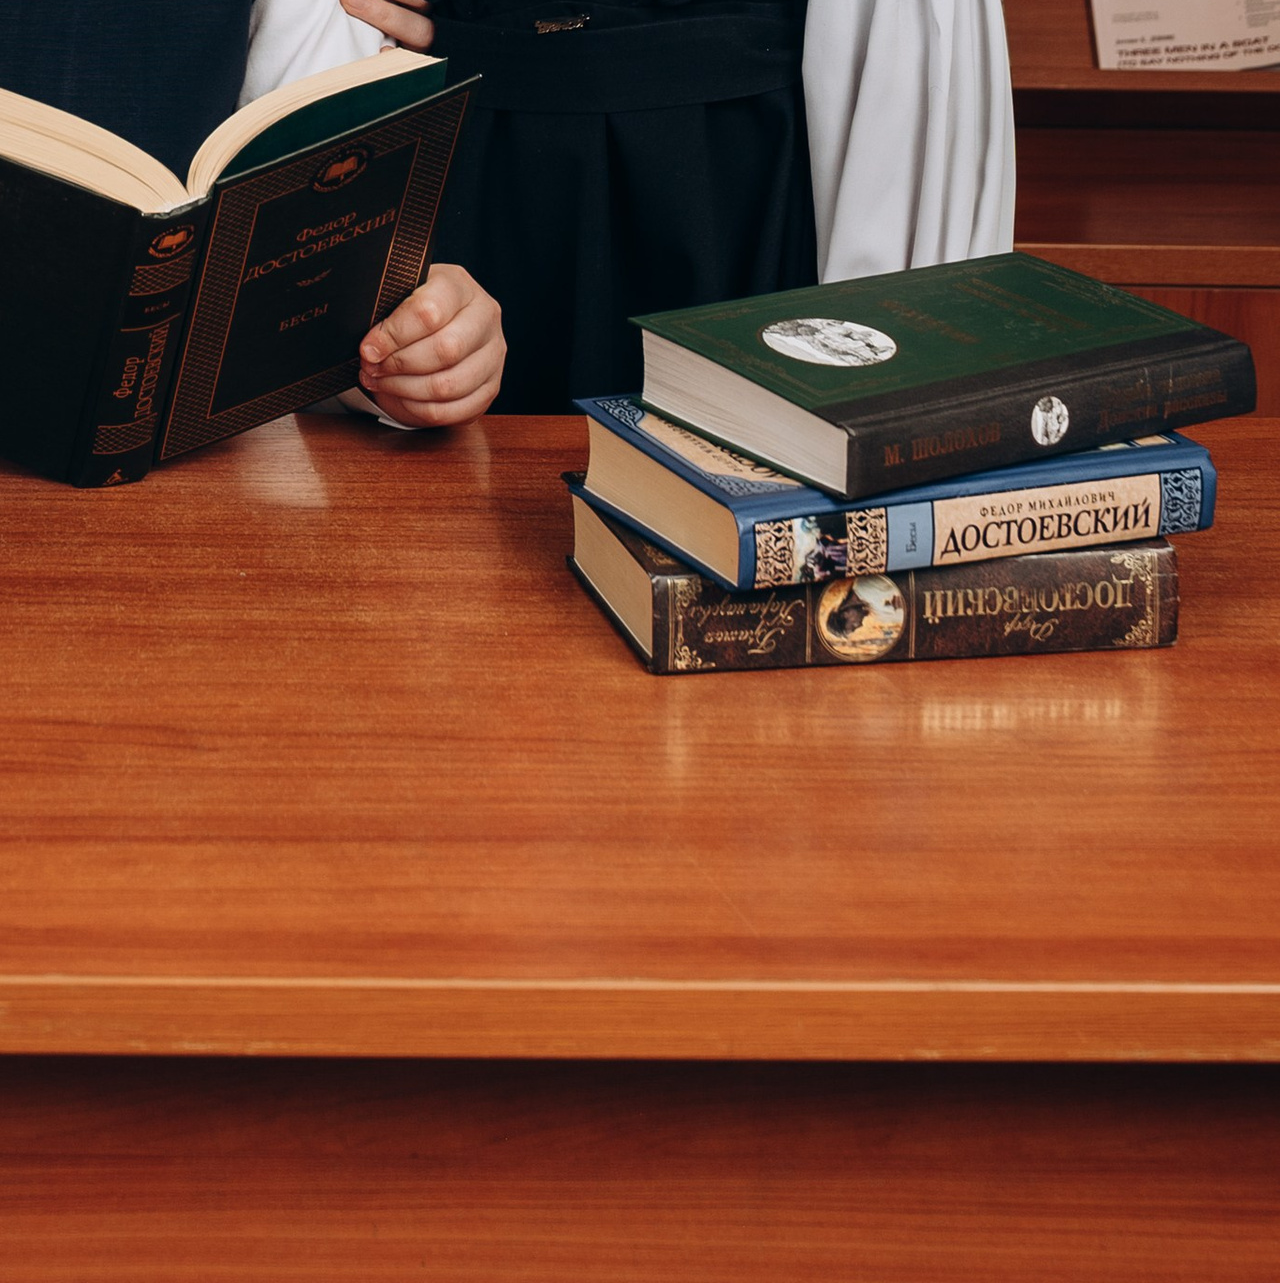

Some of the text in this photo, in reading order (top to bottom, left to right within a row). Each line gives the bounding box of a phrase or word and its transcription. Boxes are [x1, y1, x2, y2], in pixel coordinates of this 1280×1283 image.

[242, 207, 397, 284] ДОСТОЕВСКИЙ
[296, 211, 357, 242] Федор
[278, 303, 329, 333] БЕСЫ
[113, 355, 146, 399] Федор
[134, 321, 170, 419] ДОСТОЕВСКИЙ
[883, 422, 1003, 467] М. ШОЛОХОВ
[979, 490, 1117, 519] ФЕДОР МИХАЙЛОВИЧ
[905, 522, 918, 553] Бесы
[940, 497, 1152, 560] ДОСТОЕВСКИЙ
[922, 578, 1135, 625] ДОСТОЕВСКИЙ
